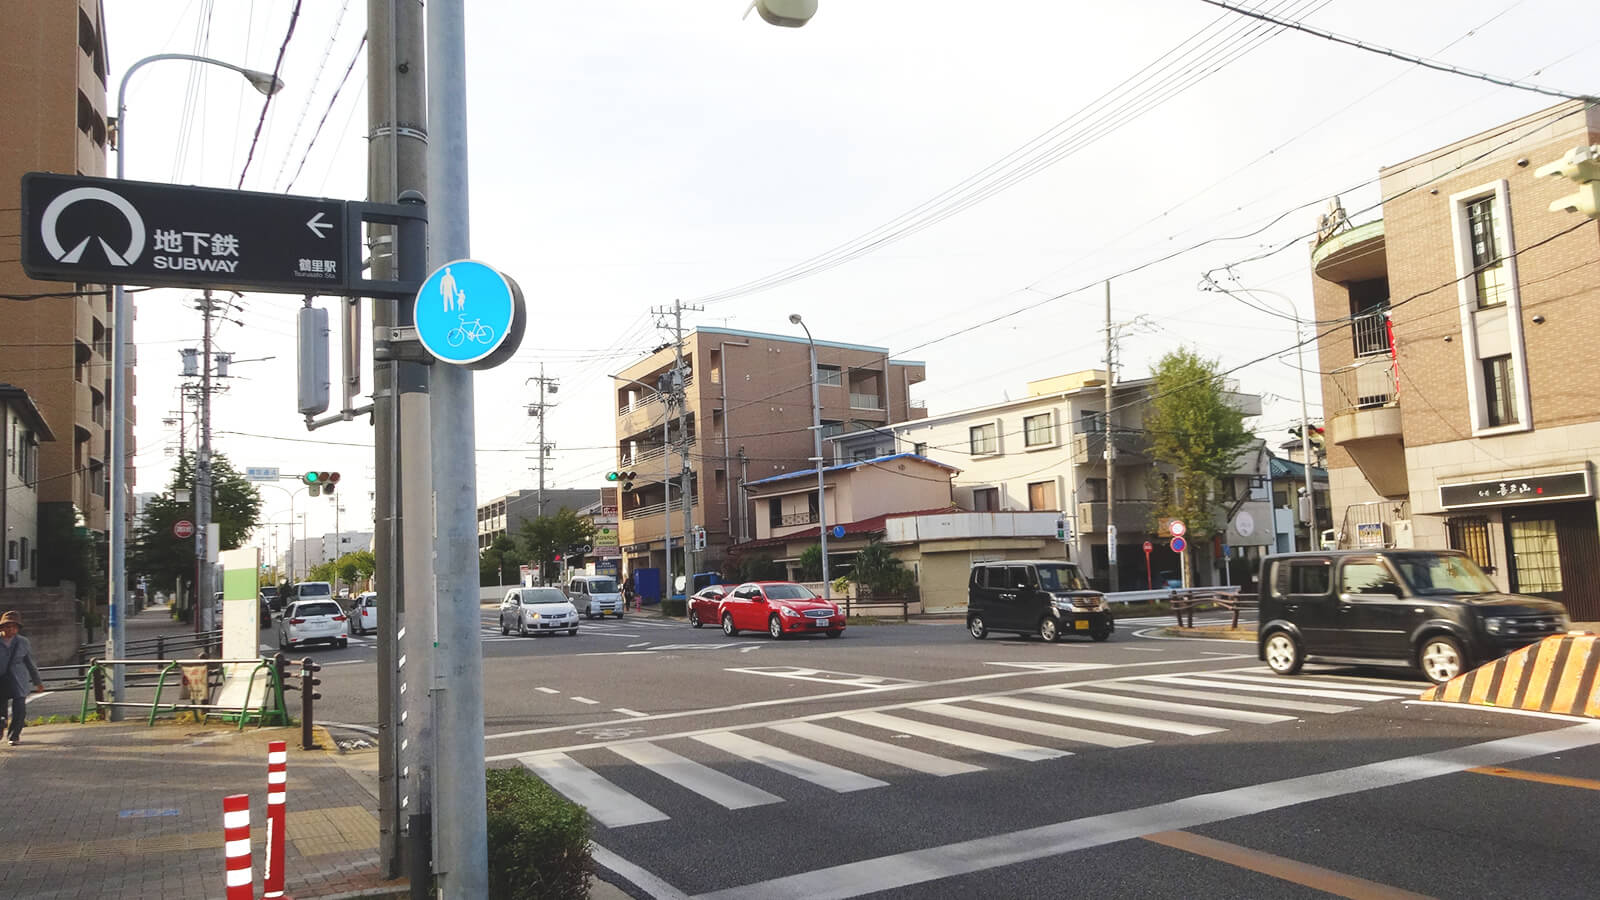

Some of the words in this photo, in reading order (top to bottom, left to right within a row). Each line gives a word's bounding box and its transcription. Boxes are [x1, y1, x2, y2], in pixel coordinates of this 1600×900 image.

[153, 229, 239, 257] 地下鉄
[153, 256, 239, 273] SUBWAY
